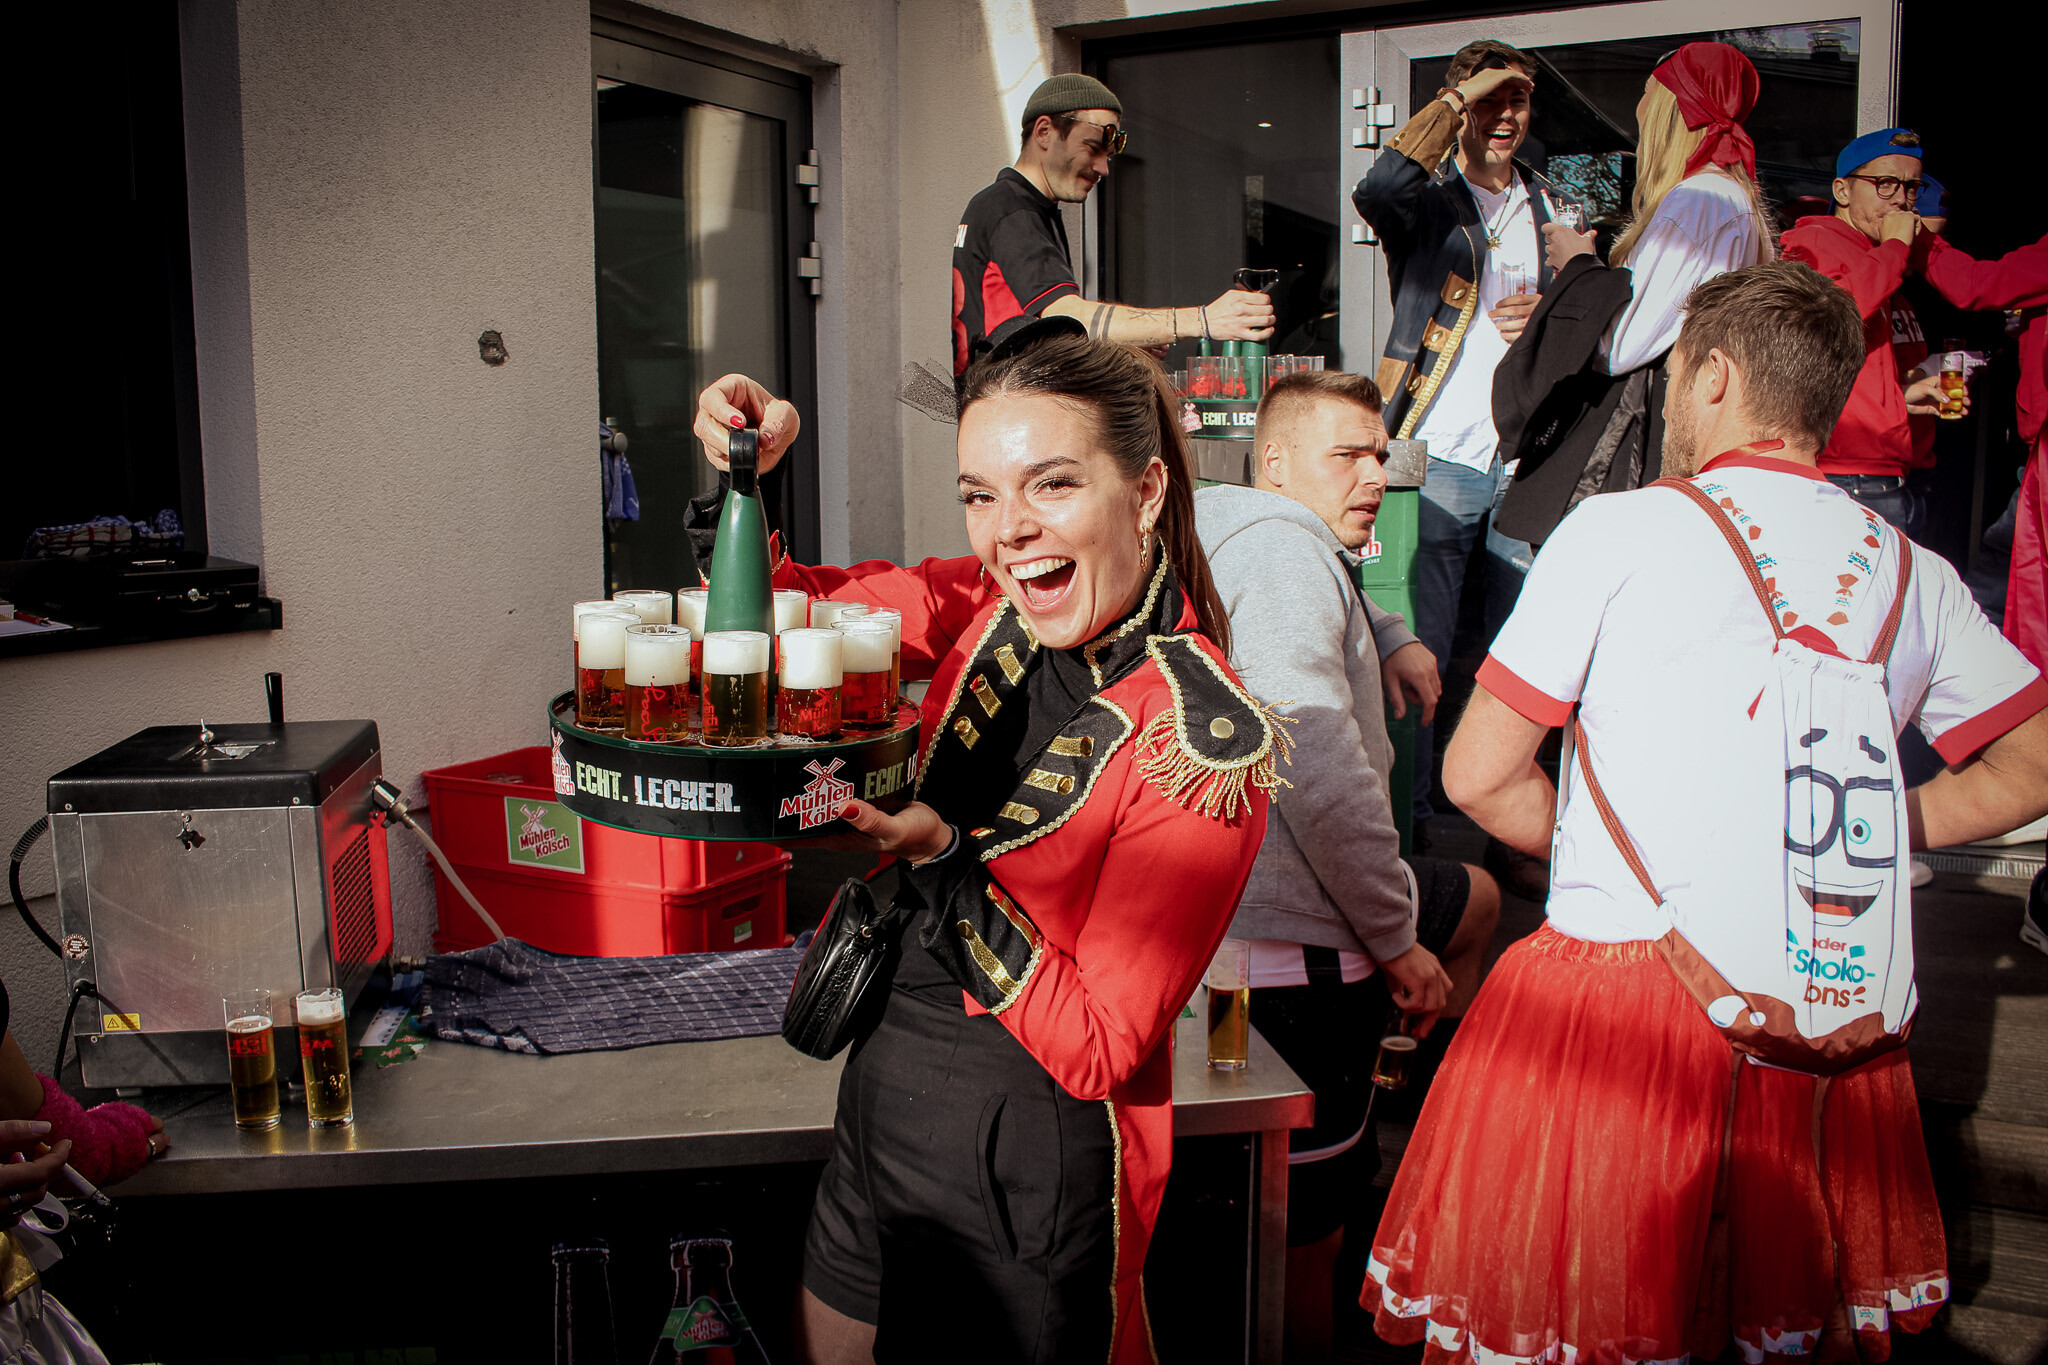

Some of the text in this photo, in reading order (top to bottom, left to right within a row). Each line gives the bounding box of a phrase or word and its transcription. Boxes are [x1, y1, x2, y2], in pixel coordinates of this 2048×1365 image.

[1202, 412, 1231, 426] ECHT.
[575, 761, 741, 813] ECHT. LECKER.
[864, 762, 905, 801] ECHT.
[779, 782, 854, 818] Mühlen
[800, 804, 839, 830] Köls
[519, 828, 556, 850] Mühlen
[535, 835, 570, 859] Kölsch
